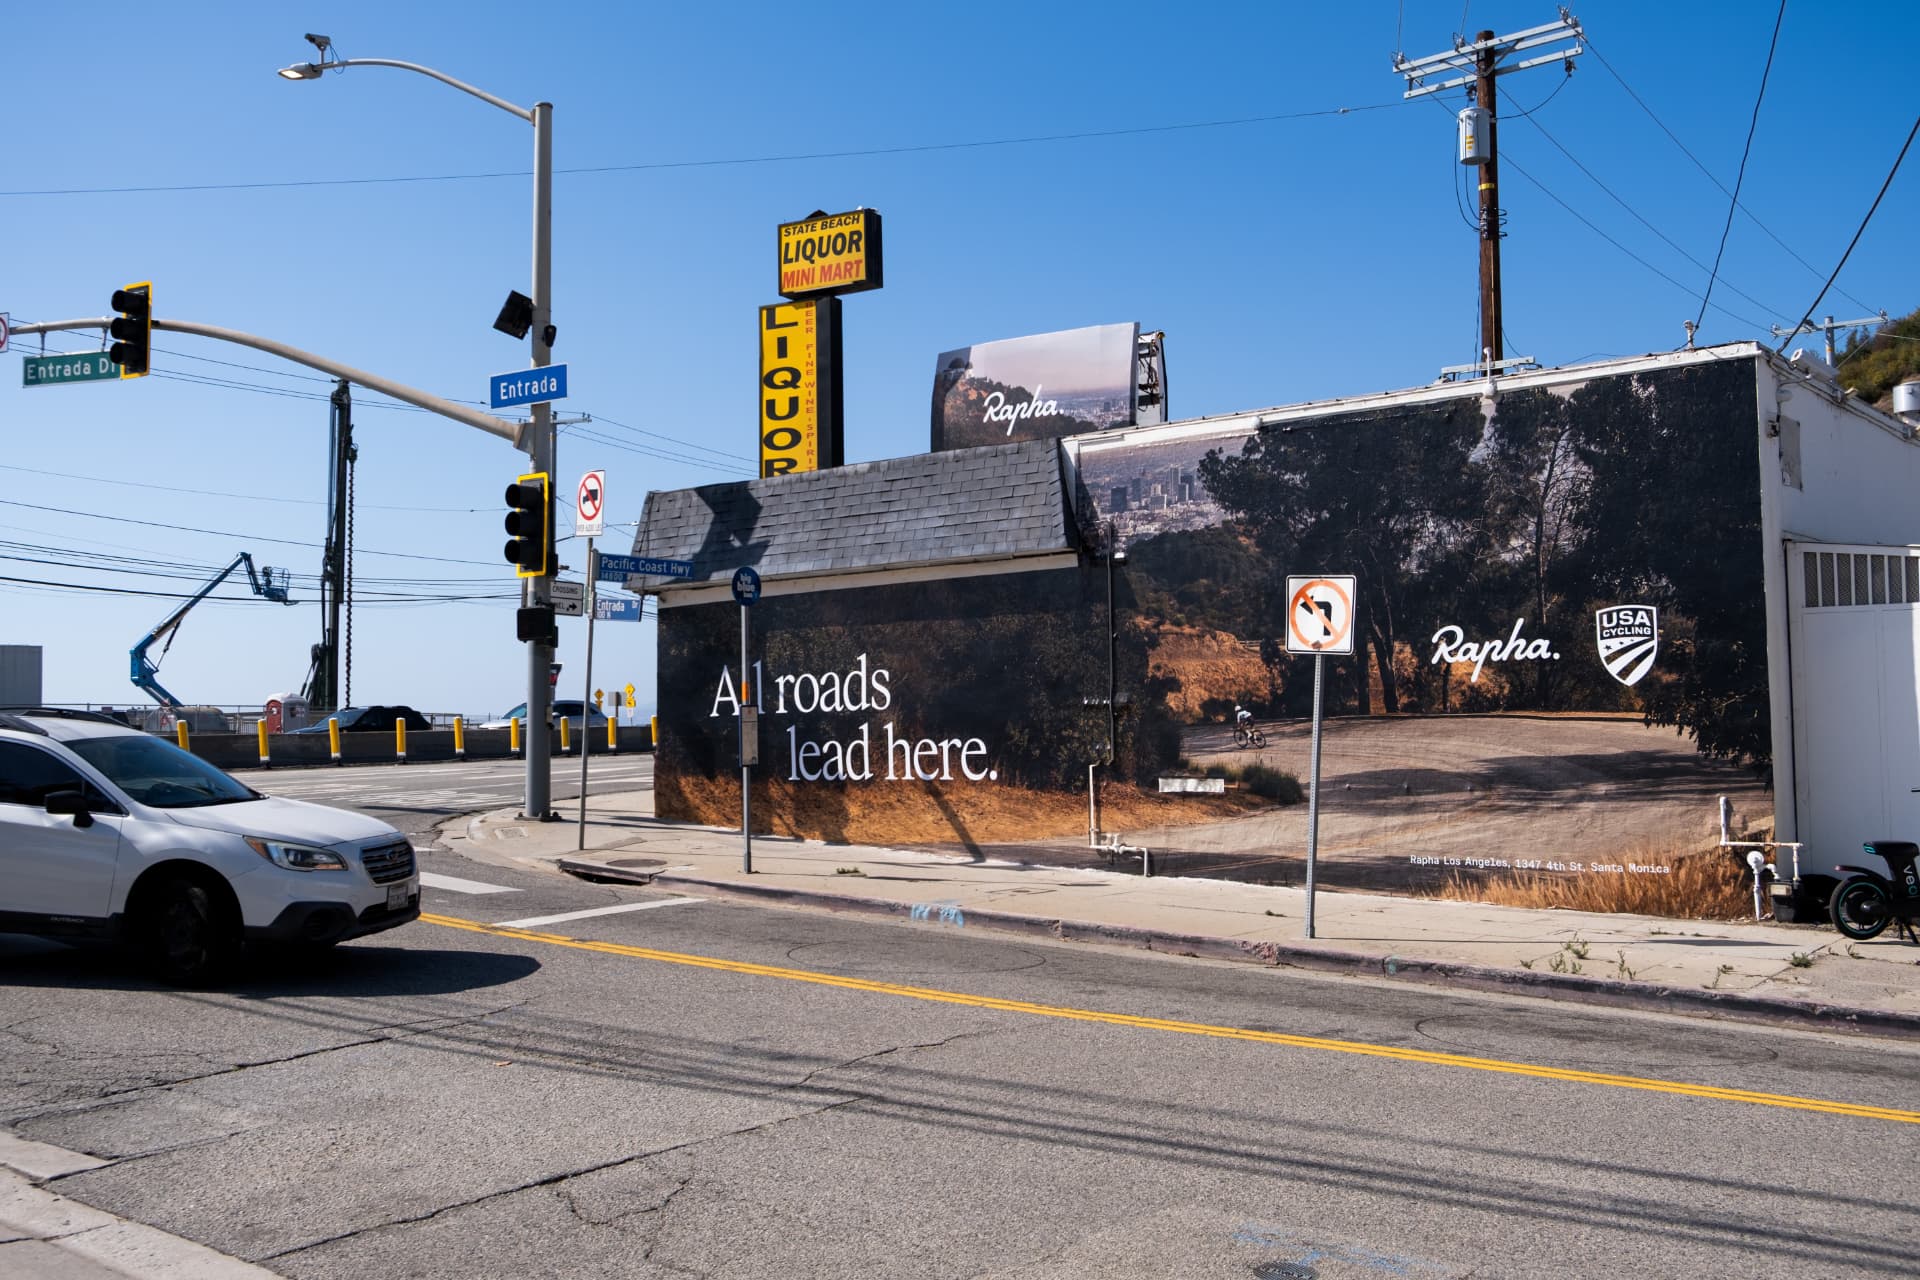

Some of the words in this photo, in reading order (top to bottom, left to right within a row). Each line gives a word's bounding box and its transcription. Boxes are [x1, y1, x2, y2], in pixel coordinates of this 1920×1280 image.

[784, 222, 818, 237] STATE
[820, 215, 861, 231] BEACH
[783, 230, 863, 264] LIQUOR
[783, 266, 815, 289] MINI
[820, 259, 863, 283] MART
[26, 360, 91, 380] Entrada
[806, 343, 814, 376] FINE
[500, 375, 557, 400] Entrada
[763, 308, 802, 480] LIQUOR
[983, 384, 1064, 436] Rapha.
[601, 556, 635, 570] Pacific
[639, 559, 668, 573] Coast
[671, 562, 690, 577] Hwy
[737, 581, 756, 592] blue
[597, 599, 625, 612] Entrada
[631, 600, 639, 608] Dr
[1602, 610, 1651, 628] USA
[1602, 626, 1651, 638] CYCLING
[1431, 617, 1561, 683] Rapha.
[709, 659, 764, 717] Al
[775, 653, 891, 714] roads
[786, 722, 873, 781] lead
[883, 721, 998, 781] here.
[1410, 854, 1440, 868] Rapha
[1443, 855, 1461, 866] Los
[1464, 856, 1512, 869] Angeles,
[1515, 858, 1541, 869] 1347
[1546, 860, 1566, 872] 4th
[1569, 861, 1586, 873] St,
[1590, 862, 1624, 873] Santa
[1628, 863, 1670, 874] Monica
[1904, 864, 1919, 896] veo
